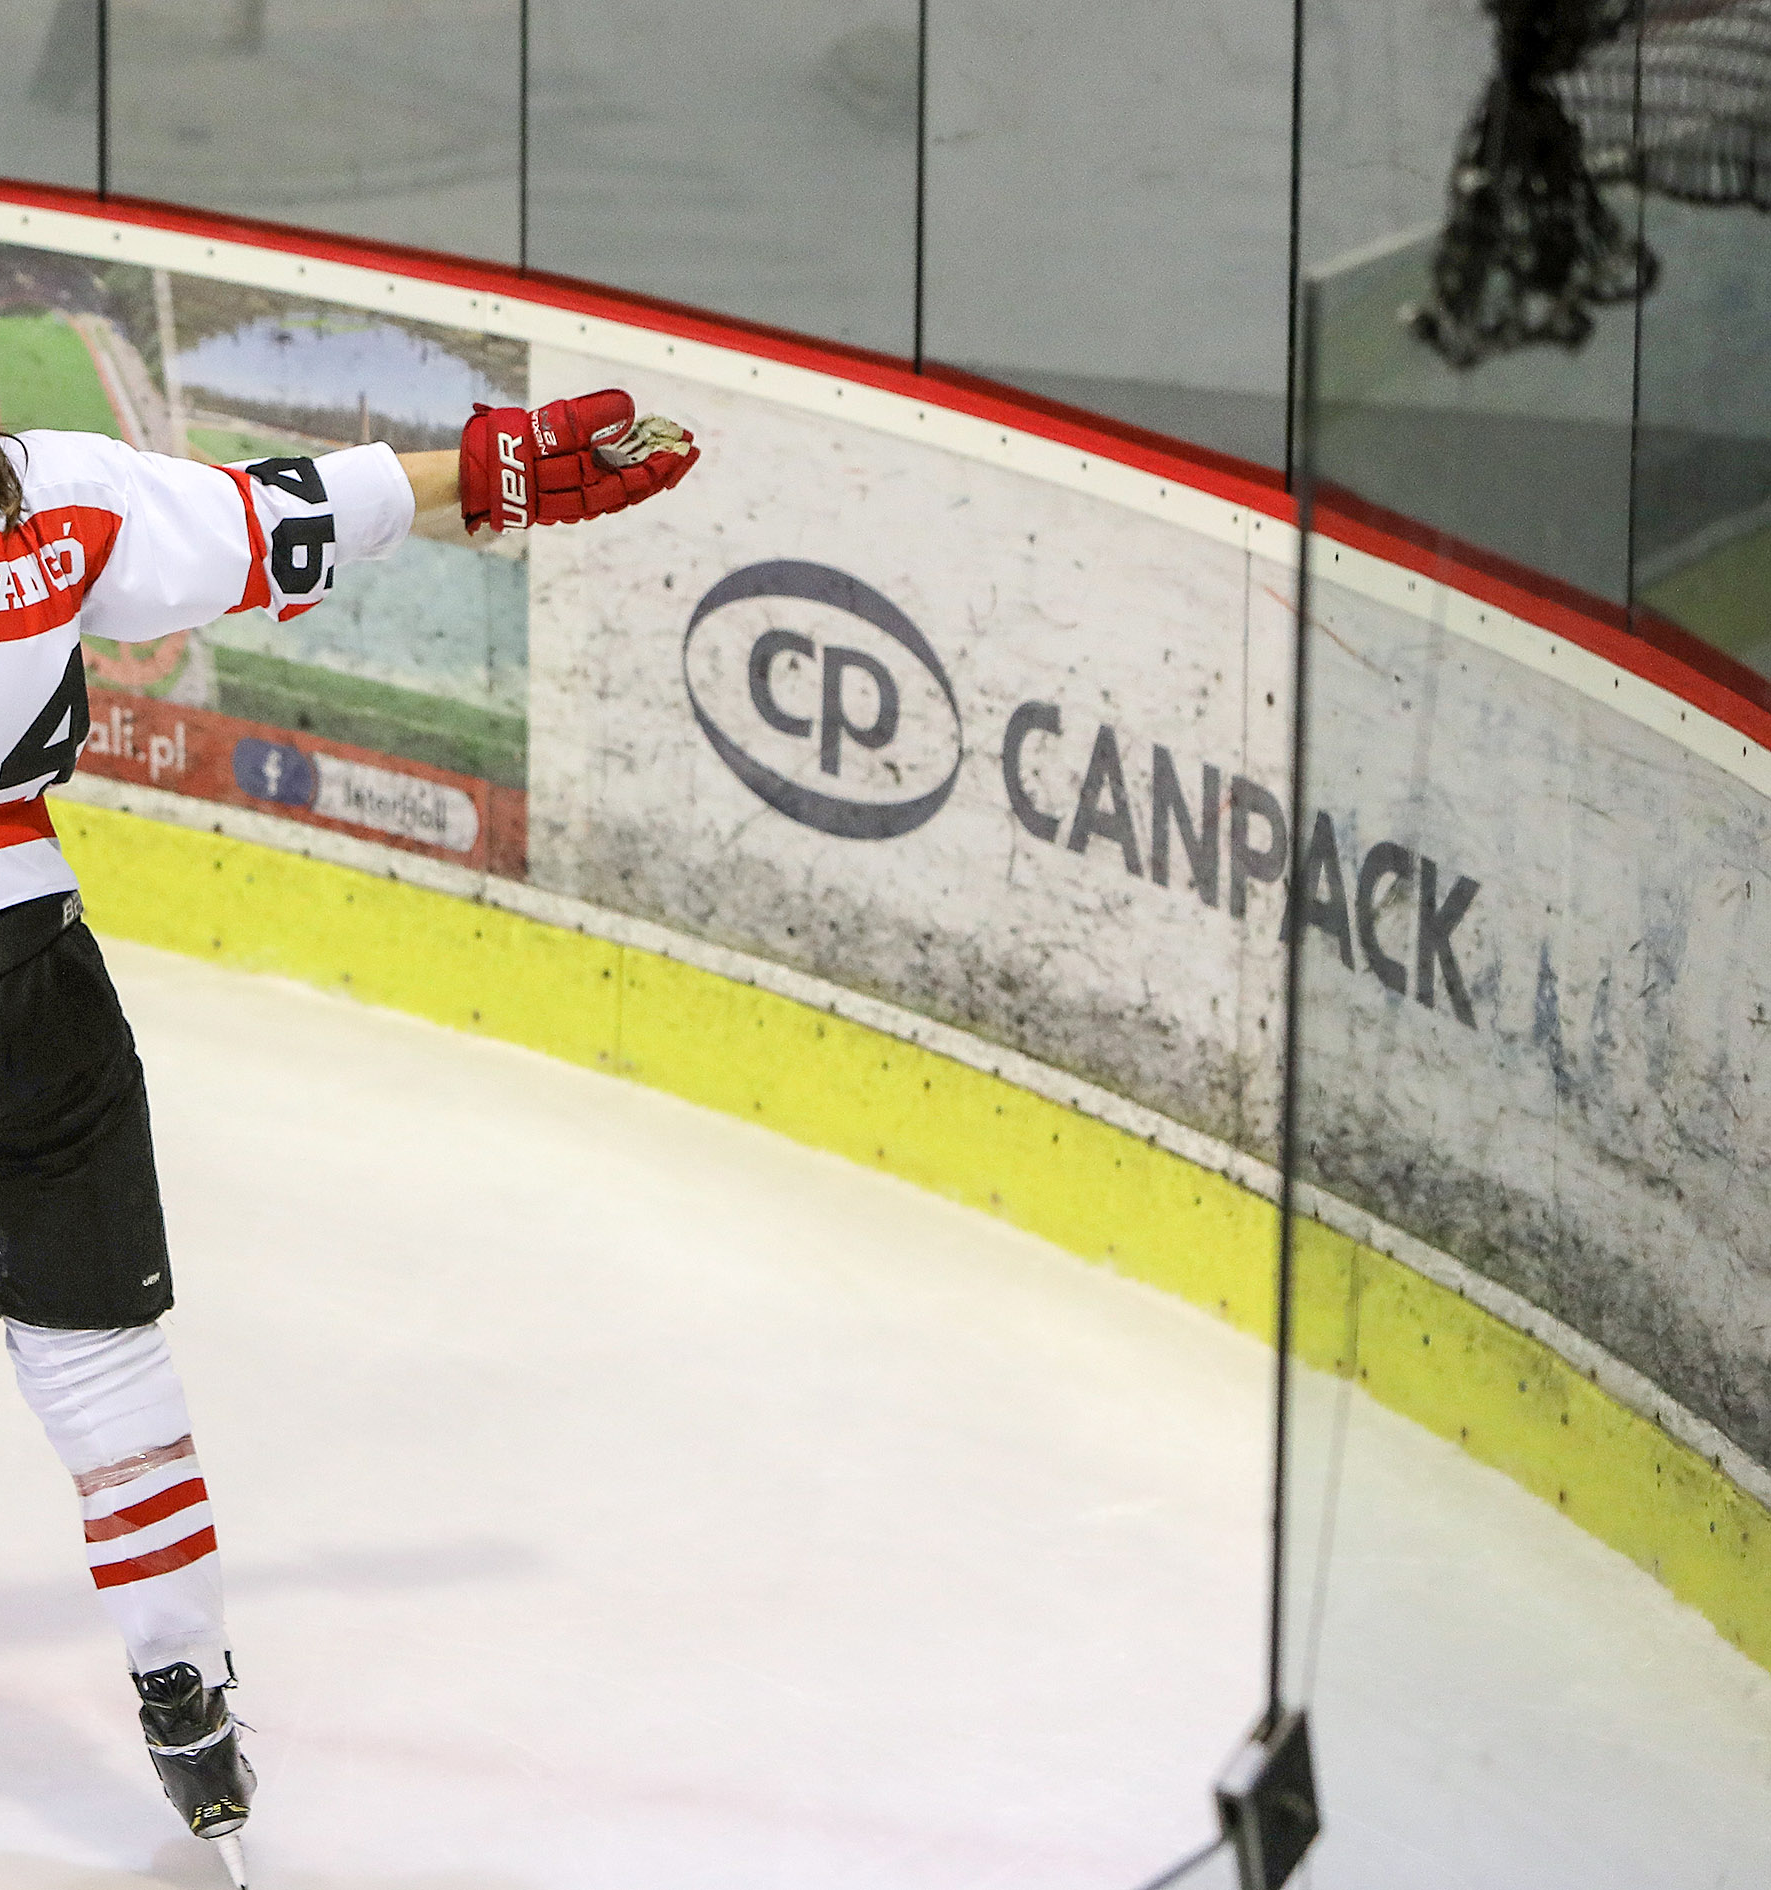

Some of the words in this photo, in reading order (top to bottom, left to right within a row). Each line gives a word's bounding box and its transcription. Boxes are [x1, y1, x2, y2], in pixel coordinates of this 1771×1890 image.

[245, 456, 336, 594] 94
[497, 431, 529, 530] UER
[1001, 699, 1482, 1031] CANPACK
